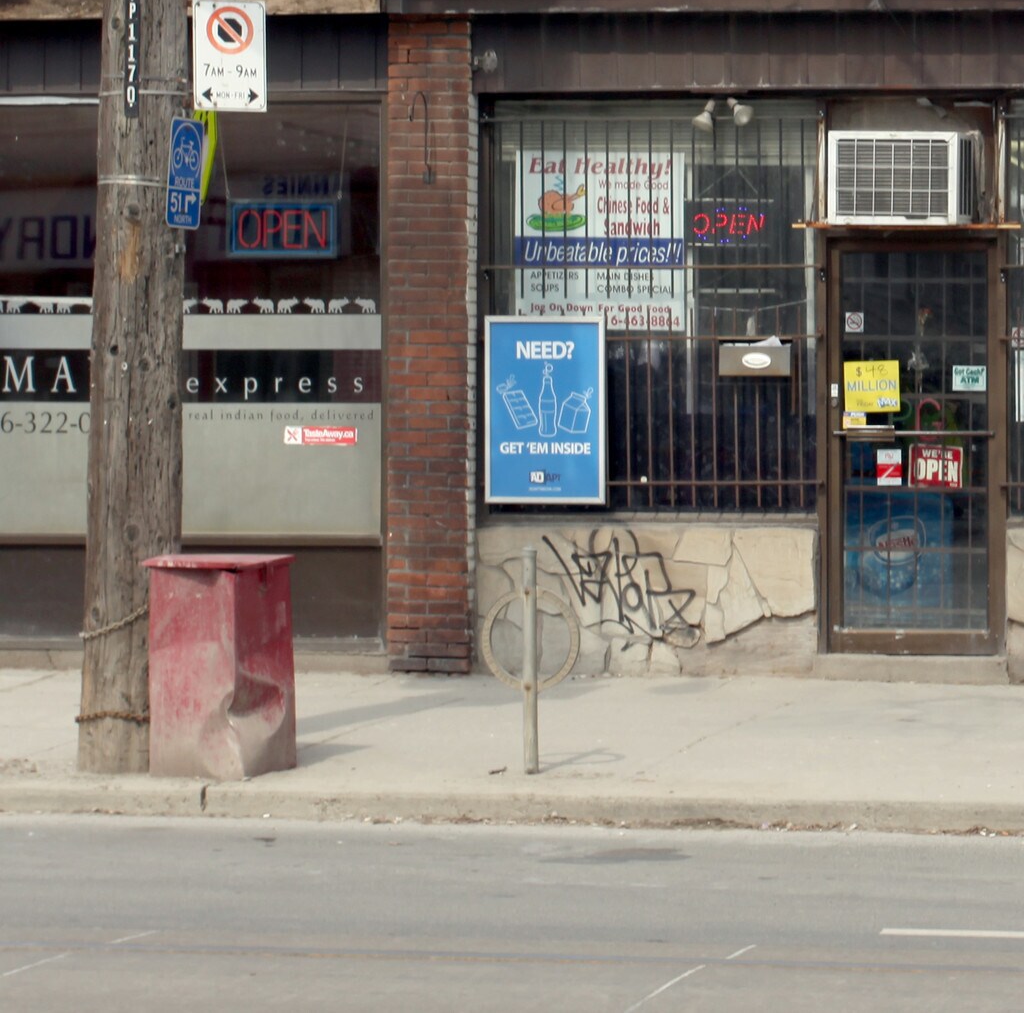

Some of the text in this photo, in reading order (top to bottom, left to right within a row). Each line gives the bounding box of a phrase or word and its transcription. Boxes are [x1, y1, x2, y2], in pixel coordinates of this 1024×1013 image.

[203, 63, 224, 77] 7AM
[235, 64, 257, 78] 9AM
[529, 157, 673, 179] Eat Healthy!
[174, 178, 195, 188] ROUTE
[644, 179, 669, 190] Good
[169, 192, 183, 213] 51
[597, 196, 670, 215] Chinese Food &
[173, 214, 193, 225] NORTH
[692, 212, 767, 235] OPEN
[238, 210, 328, 249] OPEN
[603, 218, 660, 236] Sandwich
[525, 240, 613, 263] Unbeatable
[530, 271, 579, 280] APPETIZRS
[596, 271, 655, 282] MAIN DISHE
[530, 284, 560, 293] SOUPS
[596, 285, 635, 294] COMBO
[530, 303, 546, 315] Jog
[549, 303, 564, 312] On
[566, 303, 593, 312] Down
[598, 304, 614, 313] For
[618, 304, 643, 314] Good
[516, 340, 575, 360] NEED?
[186, 375, 364, 400] express
[847, 379, 897, 392] MILLION
[188, 409, 214, 420] real
[220, 409, 264, 420] indian
[311, 409, 374, 421] delivered
[499, 441, 525, 455] GET
[551, 441, 591, 455] INSIDE
[913, 458, 959, 482] OPEN
